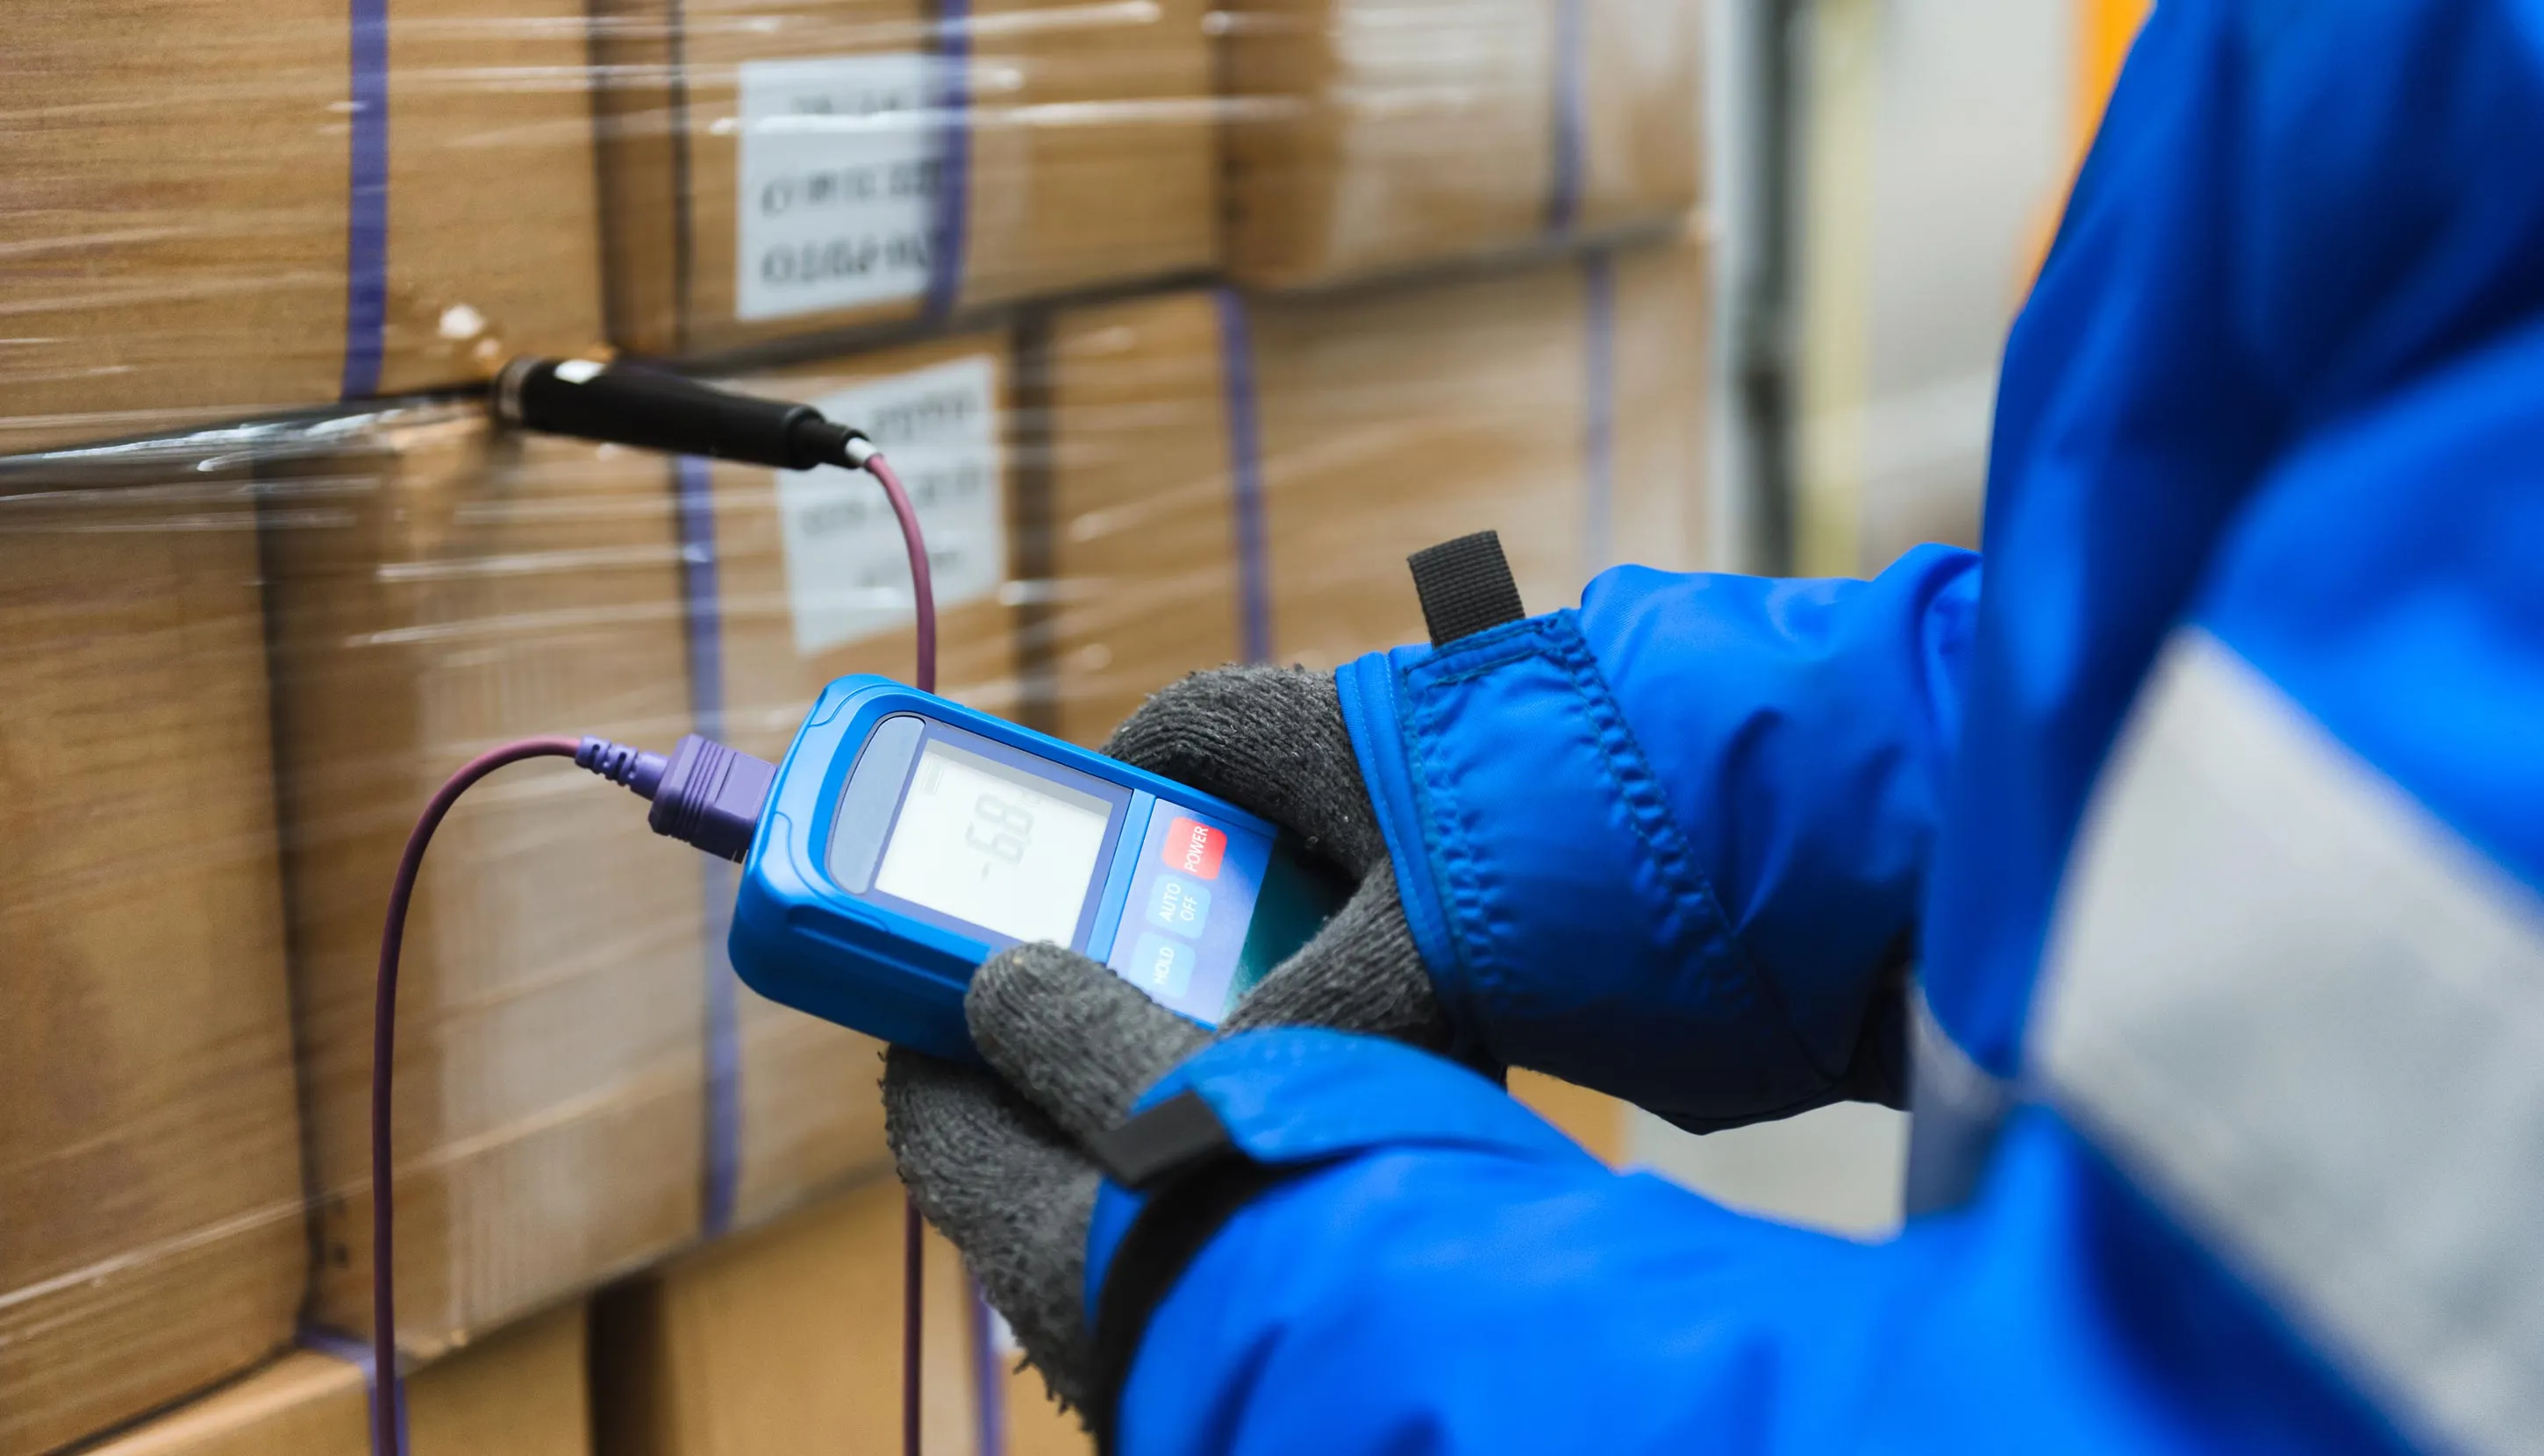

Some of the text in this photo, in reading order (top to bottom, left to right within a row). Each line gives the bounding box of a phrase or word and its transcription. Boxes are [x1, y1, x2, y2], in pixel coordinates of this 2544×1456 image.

[1184, 825, 1209, 873] POWER
[1158, 882, 1182, 922] AUTO
[1180, 894, 1198, 922] OFF
[1153, 946, 1176, 986] HOLD
